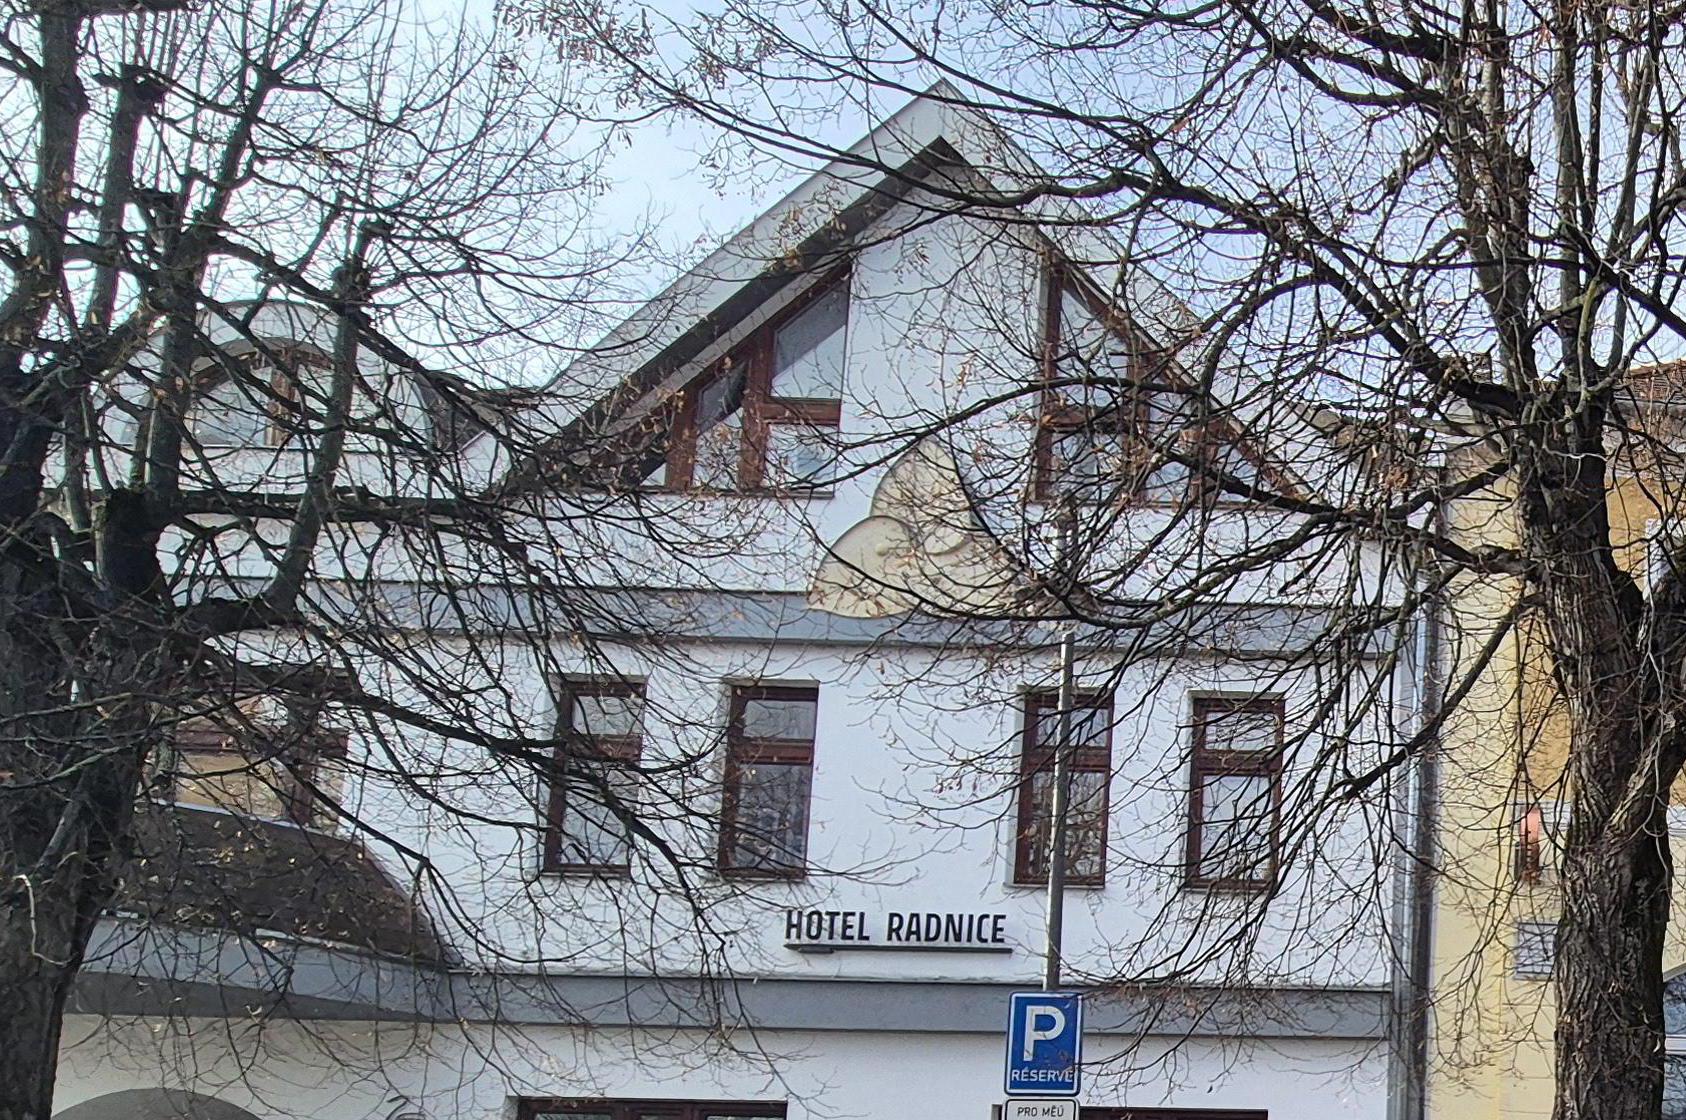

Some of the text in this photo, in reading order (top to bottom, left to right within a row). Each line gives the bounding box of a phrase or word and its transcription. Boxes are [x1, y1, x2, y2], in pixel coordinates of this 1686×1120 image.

[785, 910, 1007, 943] HOTEL RADNICE
[1023, 1005, 1066, 1062] P
[1017, 1107, 1038, 1117] PRO
